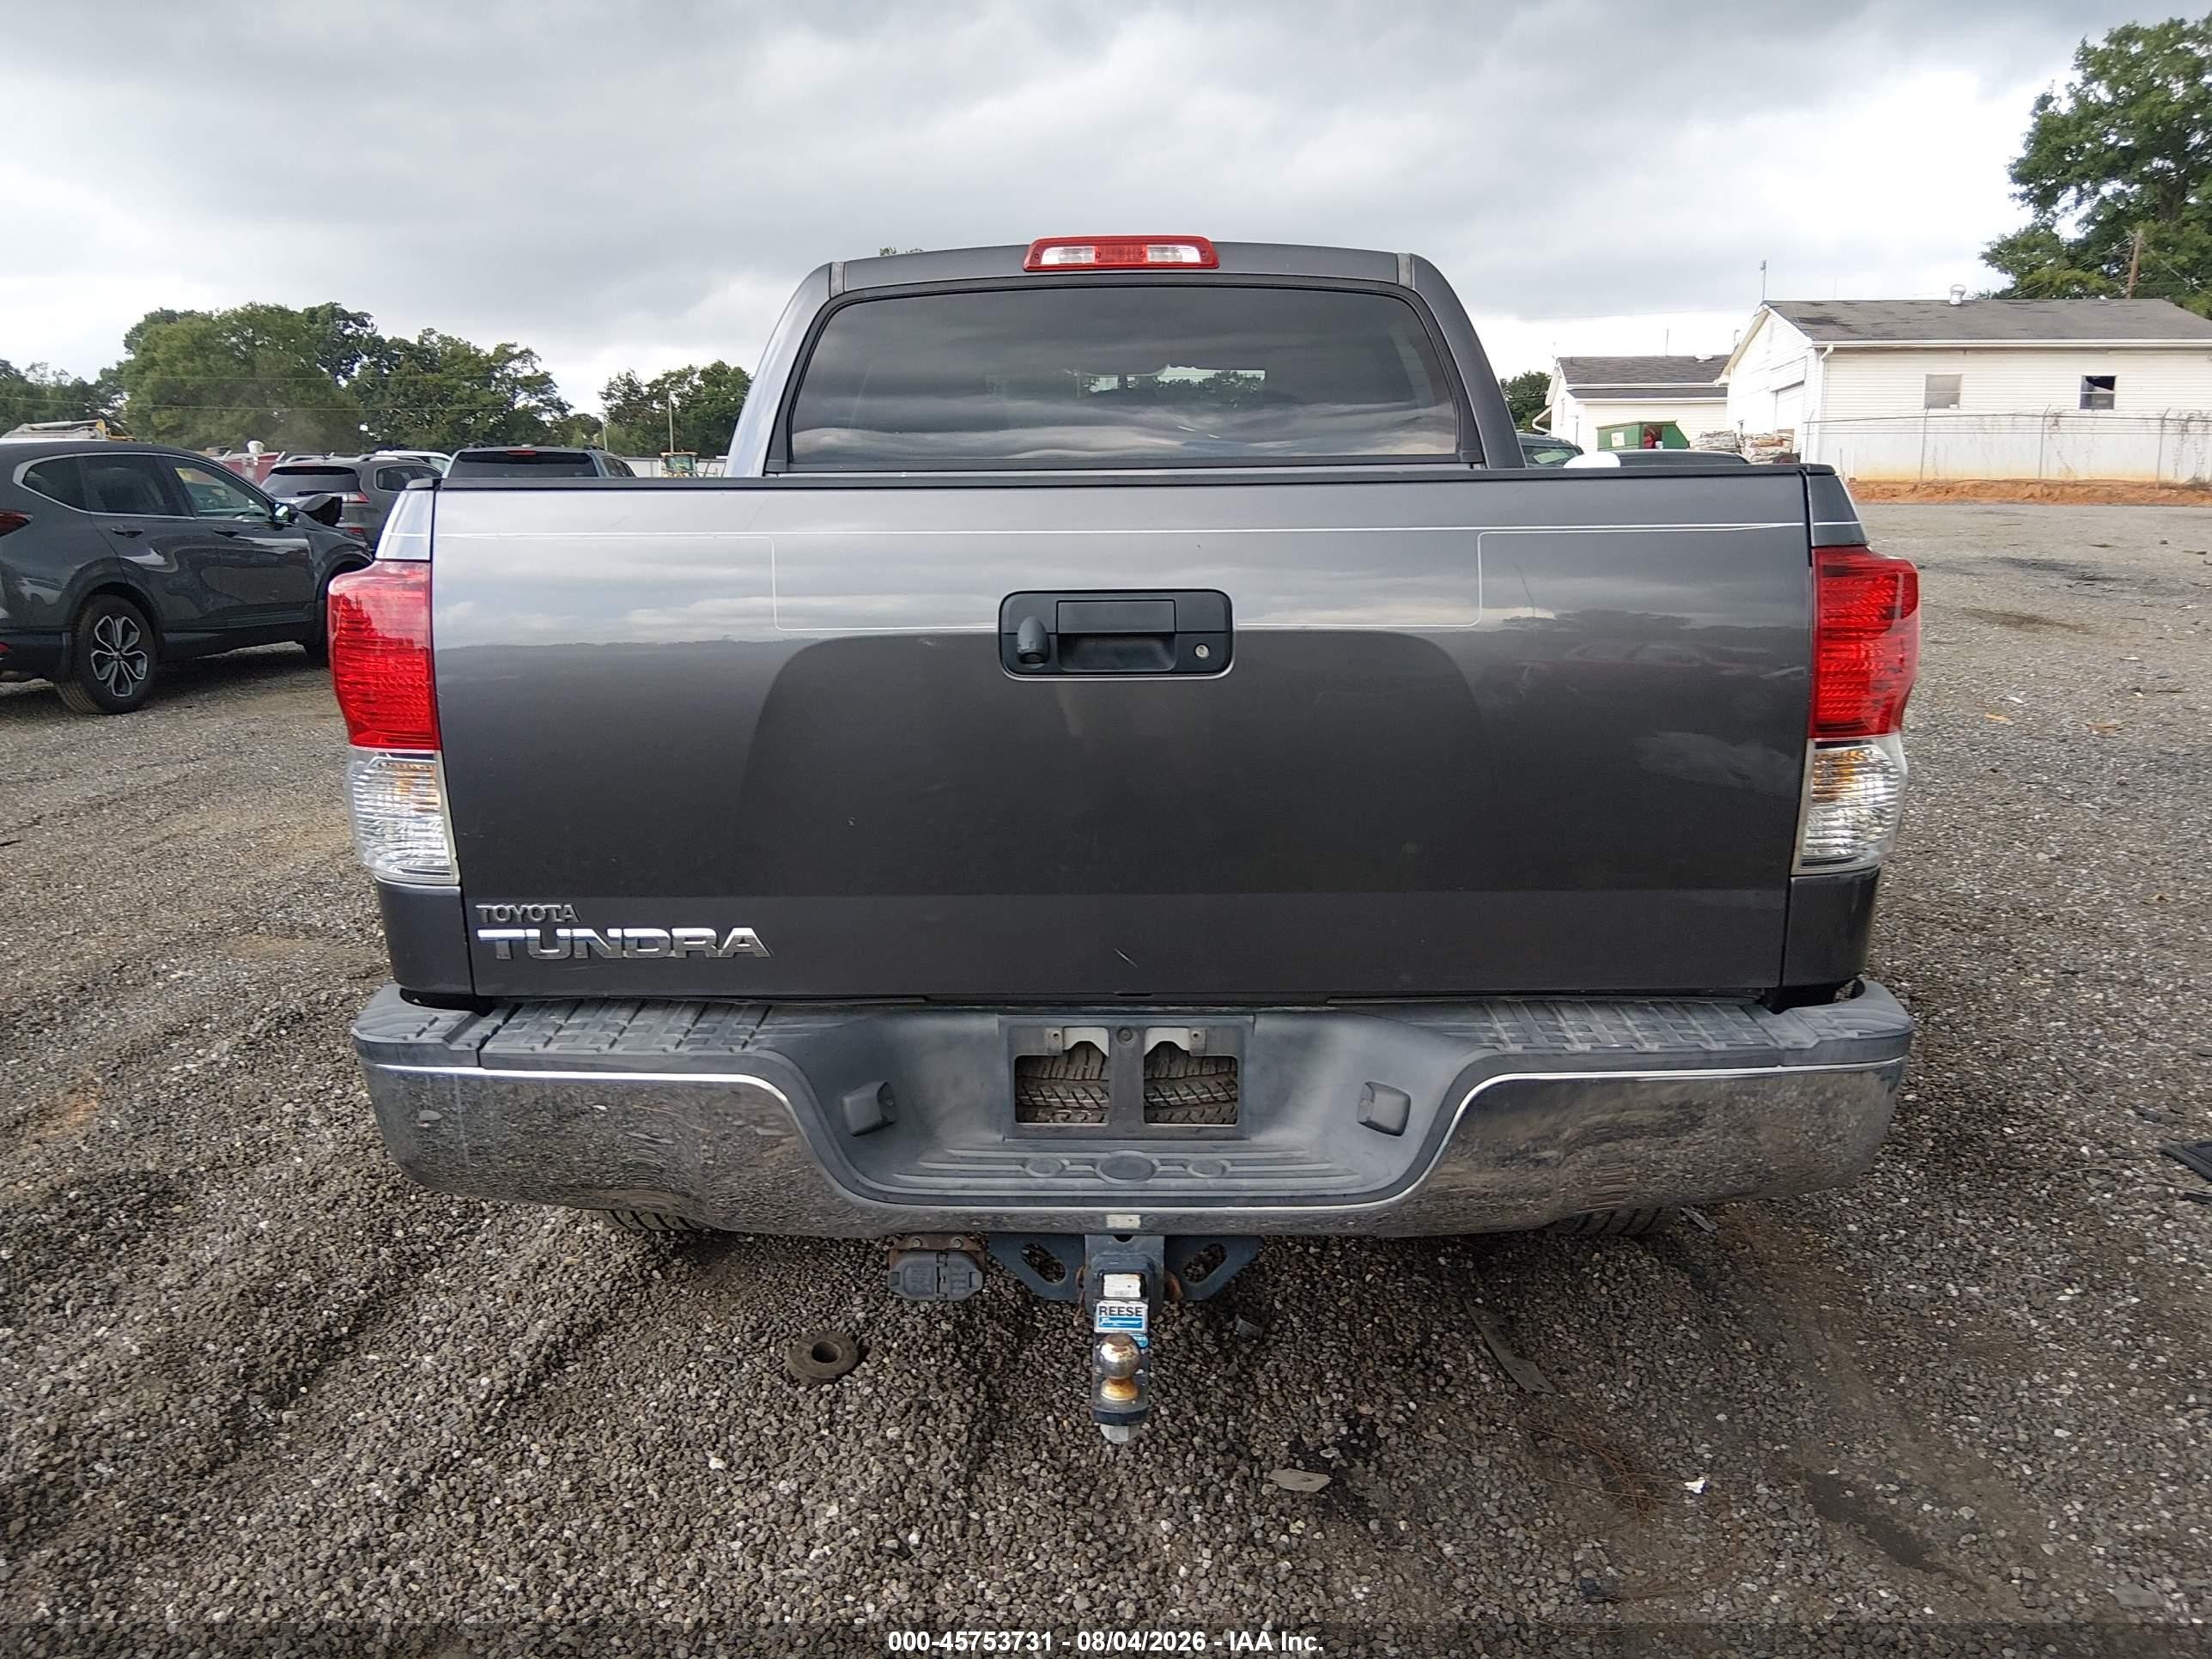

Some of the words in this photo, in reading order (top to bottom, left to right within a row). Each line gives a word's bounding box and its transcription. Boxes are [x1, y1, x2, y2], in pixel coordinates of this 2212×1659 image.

[475, 904, 580, 922] TOYOTA
[477, 927, 771, 959] TUNDRA
[1099, 1305, 1143, 1316] REESE
